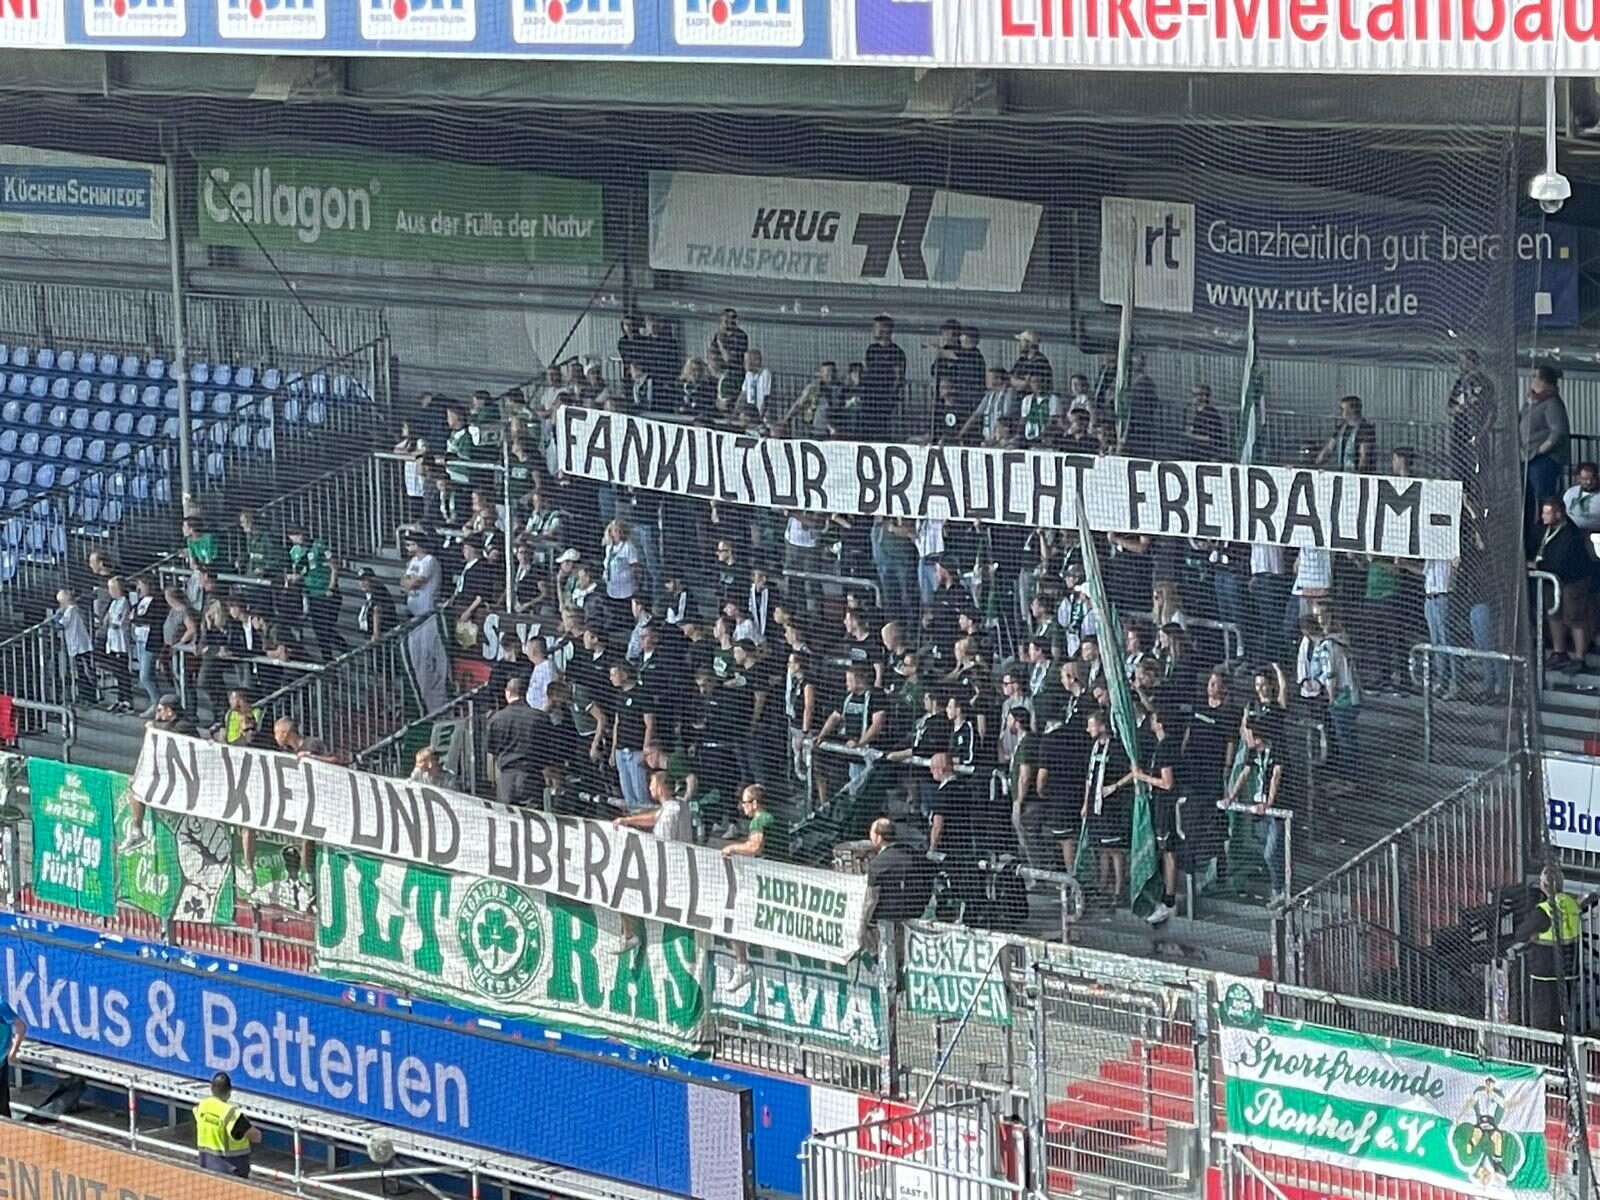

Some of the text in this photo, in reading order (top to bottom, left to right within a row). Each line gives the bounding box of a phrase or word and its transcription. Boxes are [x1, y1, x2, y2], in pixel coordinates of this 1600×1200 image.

[204, 167, 371, 243] Cellagon
[396, 210, 425, 234] Aus
[431, 210, 459, 236] der
[508, 213, 538, 237] der
[543, 214, 594, 238] Natur
[751, 207, 841, 242] KRUG
[686, 243, 829, 273] TRANSPORTE
[1207, 221, 1371, 261] Ganzheitlich
[1383, 230, 1430, 271] gut
[1206, 282, 1418, 316] www.rut-kiel.de
[564, 406, 1452, 554] FANKULTUR BRAUCHT FREIRAUM-
[54, 822, 101, 868] SpVgg
[145, 734, 200, 811] IN
[221, 746, 327, 839] KIEL
[348, 772, 461, 865] UND
[484, 801, 736, 932] ÜBERALL!
[42, 851, 84, 891] Fürth
[756, 874, 847, 919] HORIDOS
[909, 973, 1009, 1020] HAUSEN
[145, 979, 191, 1063] &
[202, 990, 469, 1128] Batterien
[1241, 1035, 1445, 1098] Sportfreunde
[1244, 1087, 1436, 1156] Ronhof e.V.
